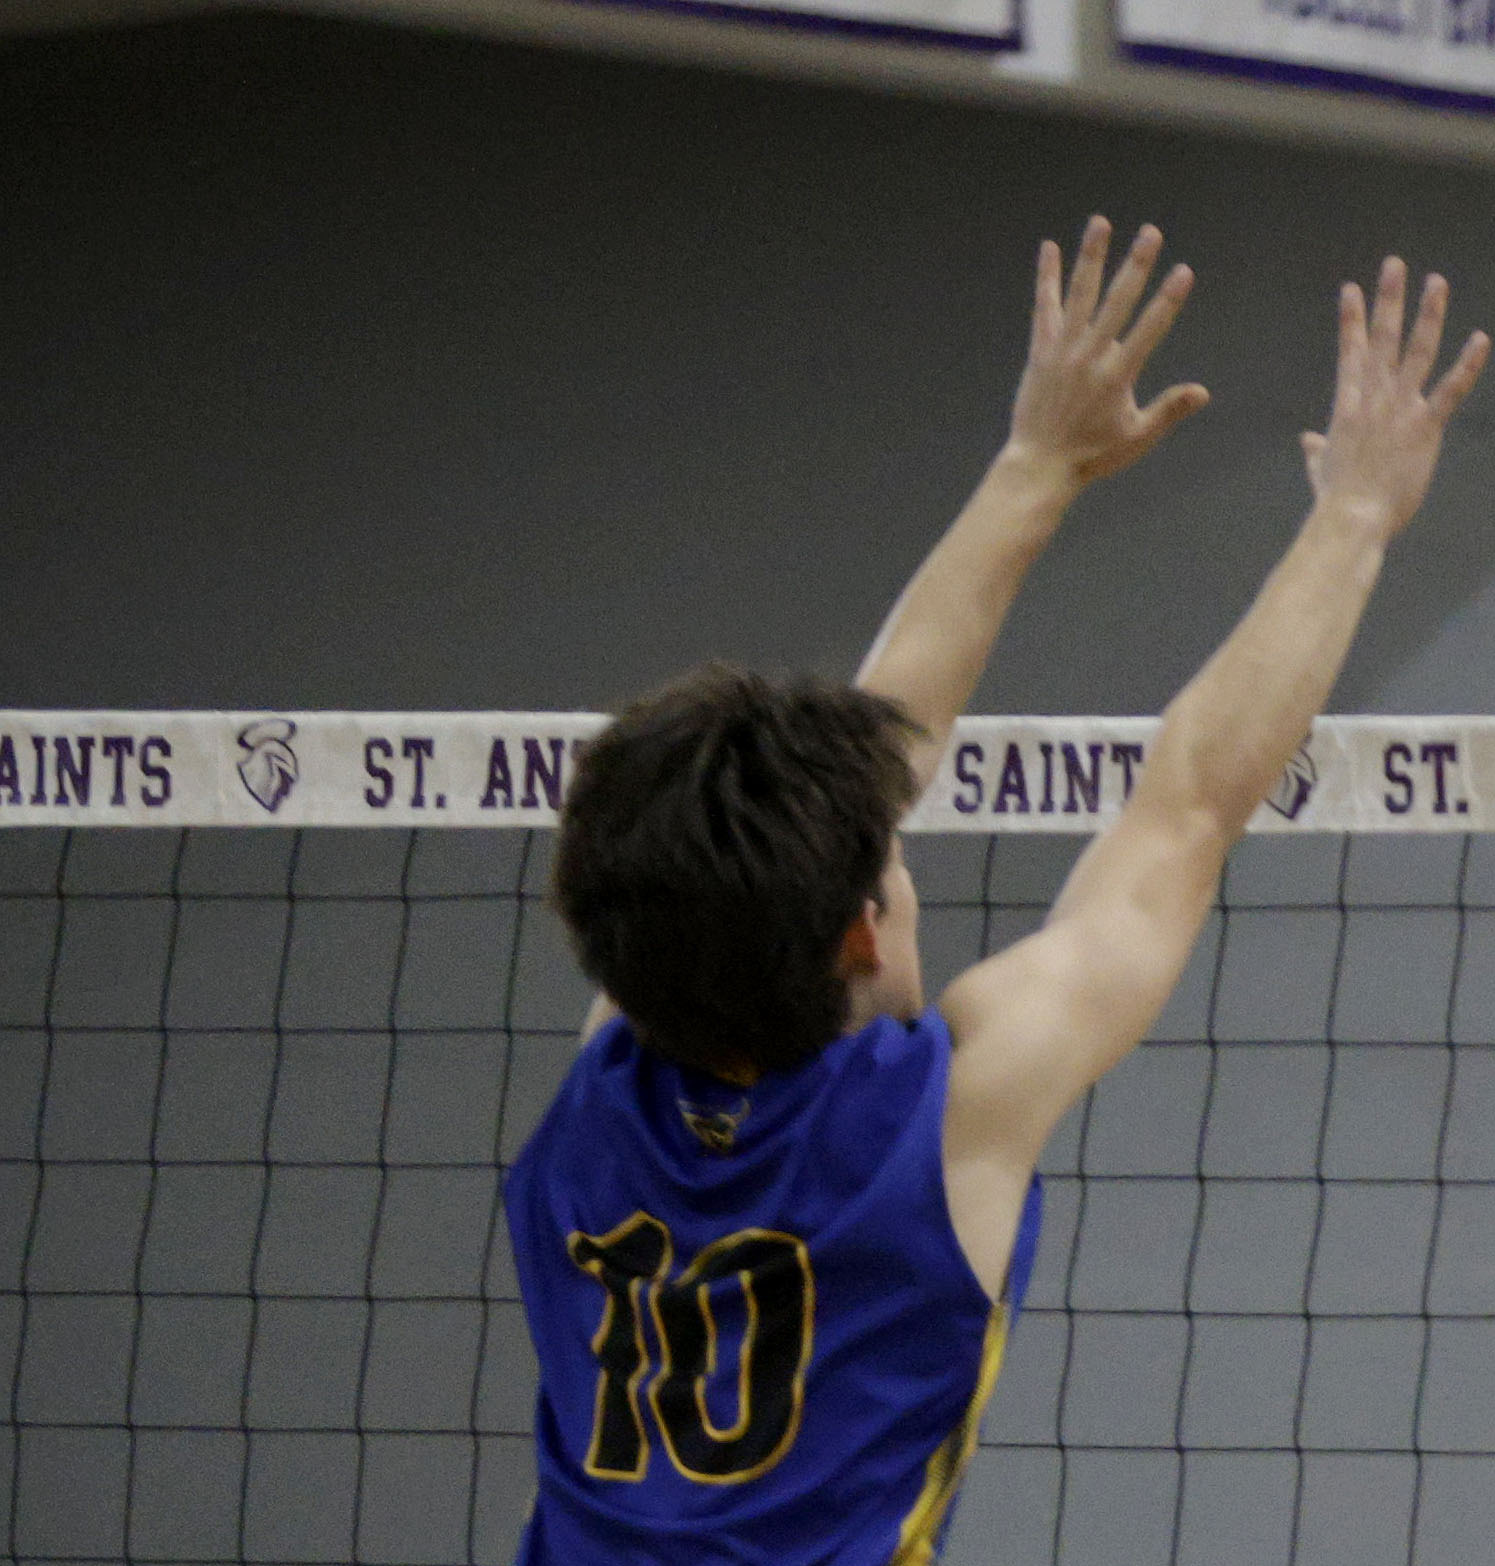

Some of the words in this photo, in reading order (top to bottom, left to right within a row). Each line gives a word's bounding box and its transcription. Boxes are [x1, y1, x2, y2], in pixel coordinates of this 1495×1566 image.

[362, 736, 447, 810] ST.
[953, 740, 1145, 815] SAINT
[1382, 739, 1470, 816] ST.
[566, 1209, 817, 1485] 10
